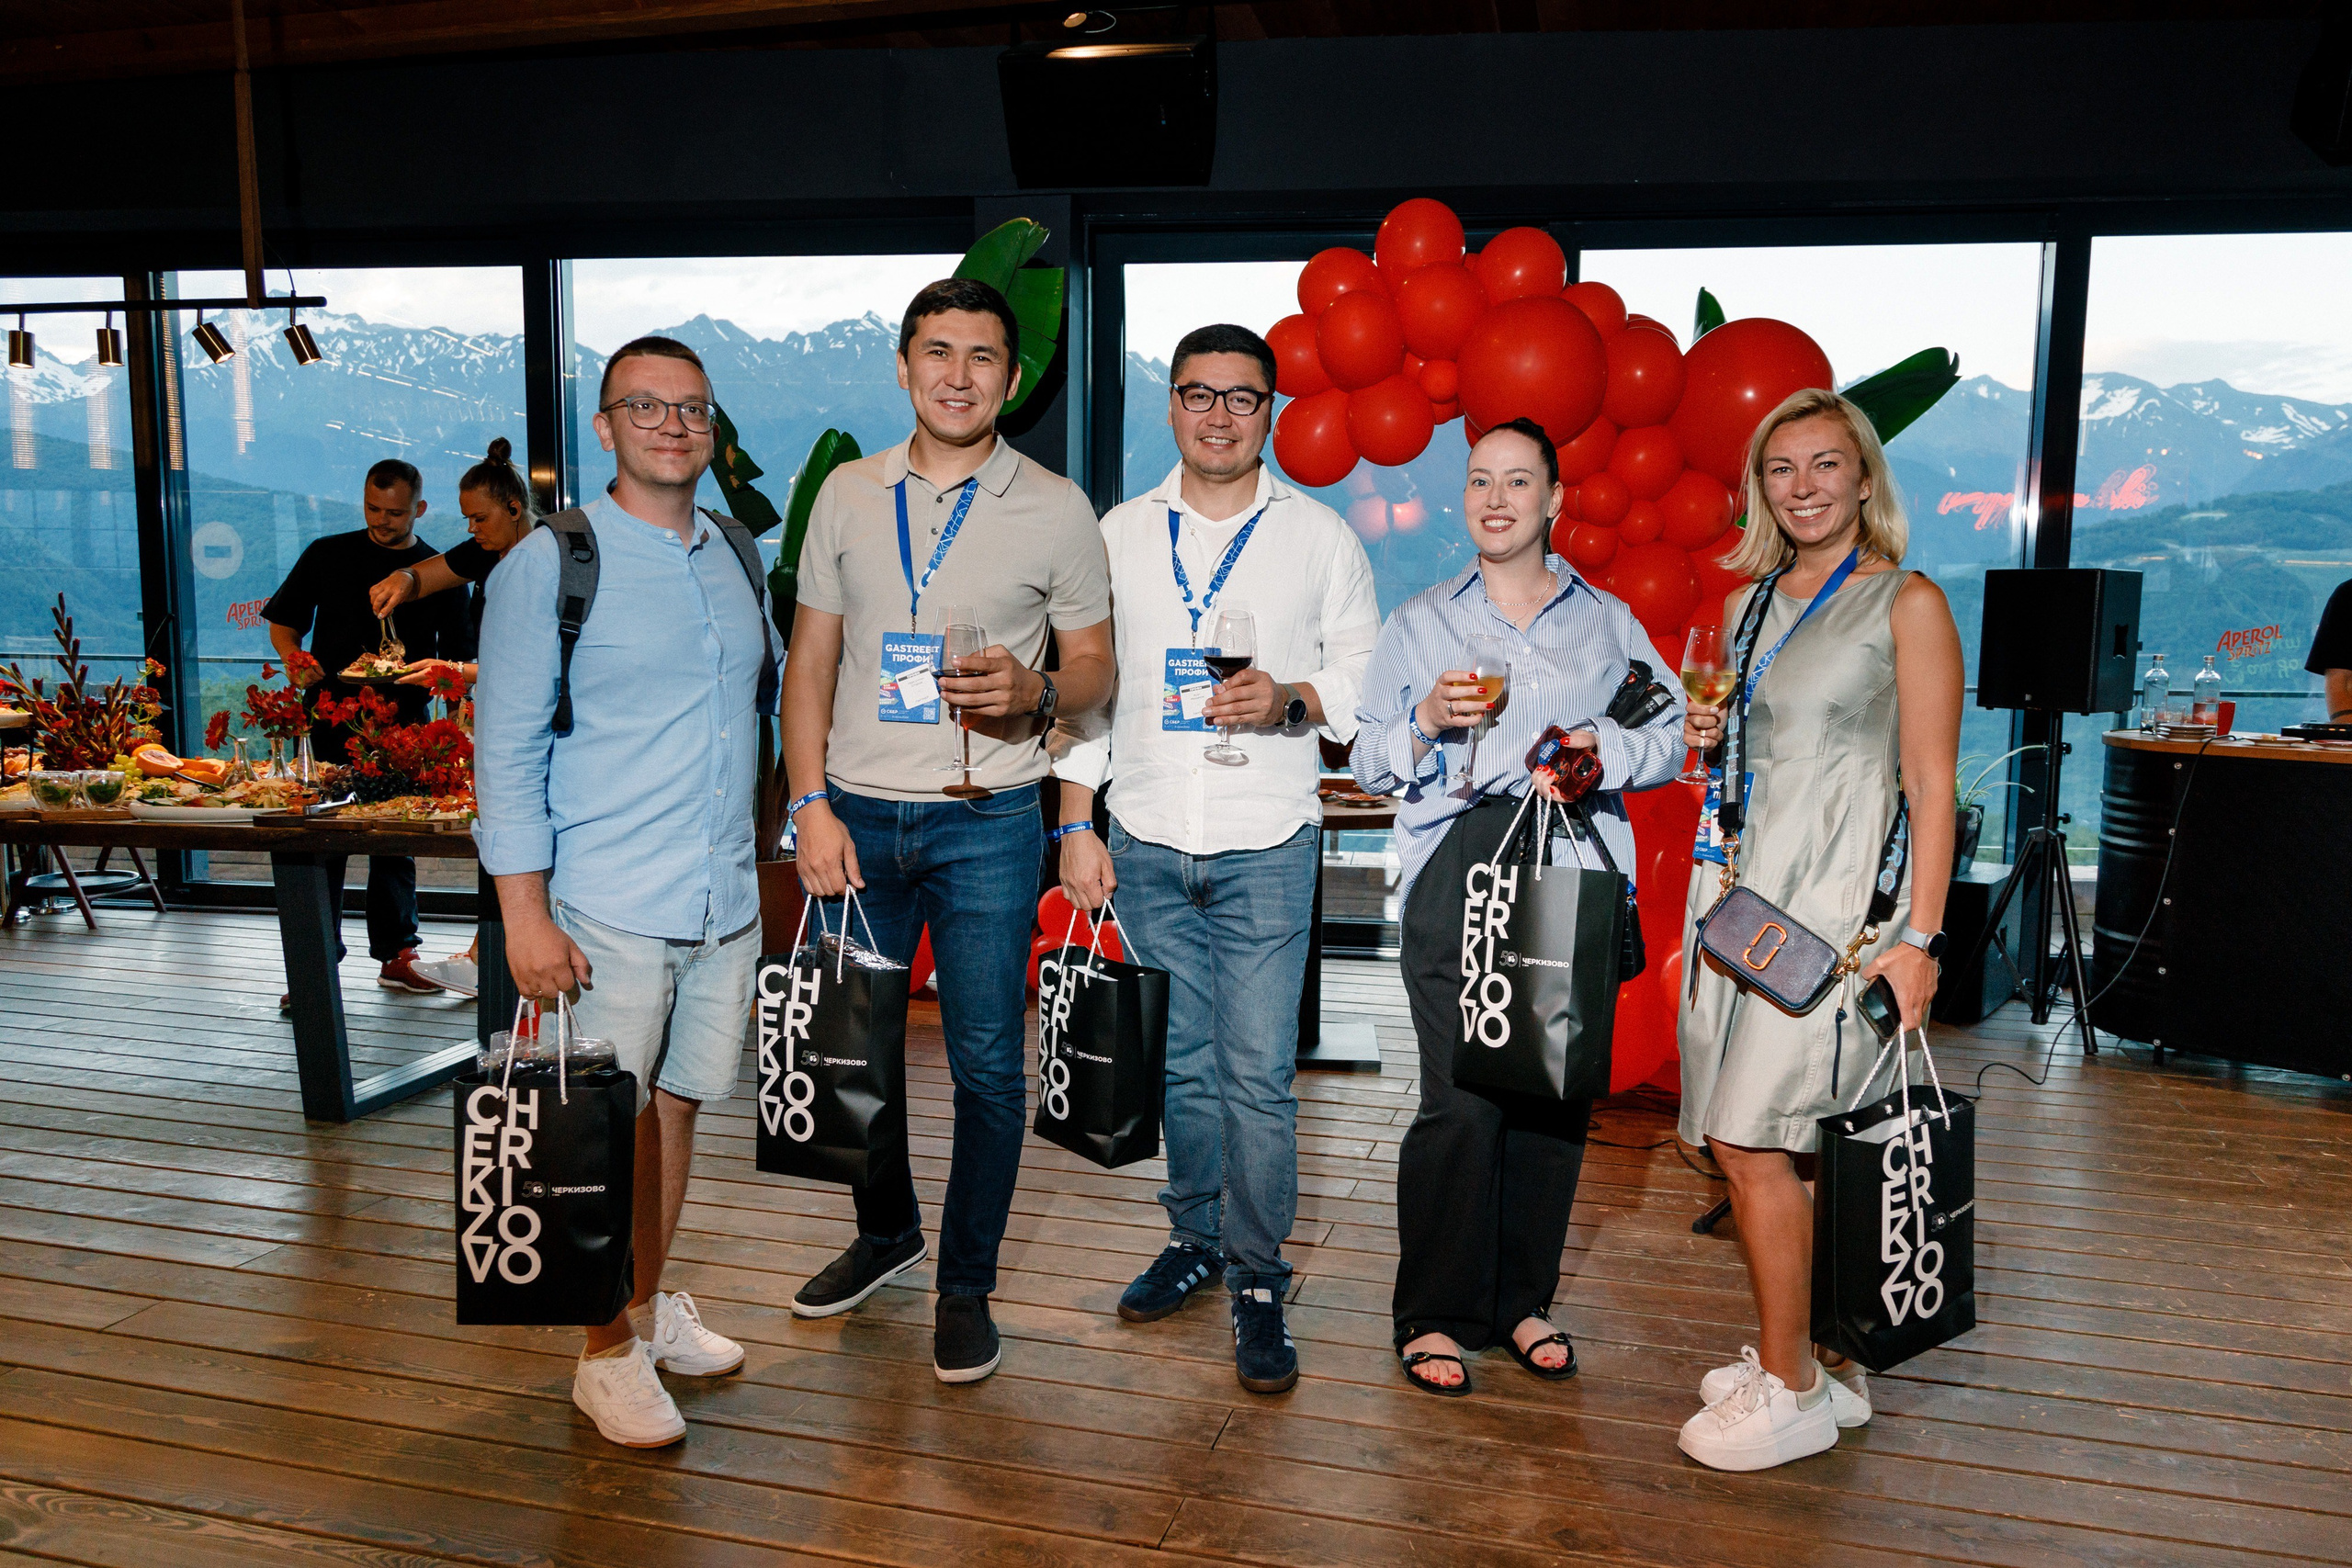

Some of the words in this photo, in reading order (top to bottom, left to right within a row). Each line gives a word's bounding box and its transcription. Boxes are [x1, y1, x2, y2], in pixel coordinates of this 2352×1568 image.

[226, 596, 272, 623] APER
[892, 654, 932, 663] ПРОФИ
[2217, 625, 2283, 652] APEROL
[1169, 659, 1207, 668] GASTRE
[1175, 668, 1209, 677] ПРОФИ
[1724, 715, 1739, 785] THE
[1878, 796, 1909, 892] ARC
[1466, 863, 1519, 904] CH
[1464, 897, 1511, 940] ER
[1462, 933, 1495, 974] KI
[1521, 957, 1570, 968] ЧЕРКИЗОВО
[758, 964, 821, 1006] CH
[1039, 960, 1078, 1003] CH
[1459, 969, 1512, 1011] ZO
[757, 998, 813, 1040] ER
[1460, 1000, 1511, 1048] VO
[758, 1032, 796, 1073] KI
[823, 1056, 867, 1066] ЧЕРКИЗОВО
[1077, 1051, 1113, 1063] ЧЕРКИЗОВО
[466, 1085, 539, 1131] CH
[759, 1066, 816, 1108] ZO
[759, 1099, 815, 1143] VO
[463, 1124, 533, 1169] ER
[1883, 1123, 1933, 1181] CH
[462, 1164, 513, 1208] KI
[551, 1185, 605, 1193] ЧЕРКИЗОВО
[1882, 1165, 1935, 1217] ER
[461, 1203, 542, 1246] ZO
[1882, 1207, 1925, 1261] KI
[461, 1240, 542, 1285] VO
[1882, 1241, 1944, 1289] ZO
[1881, 1277, 1944, 1326] VO
